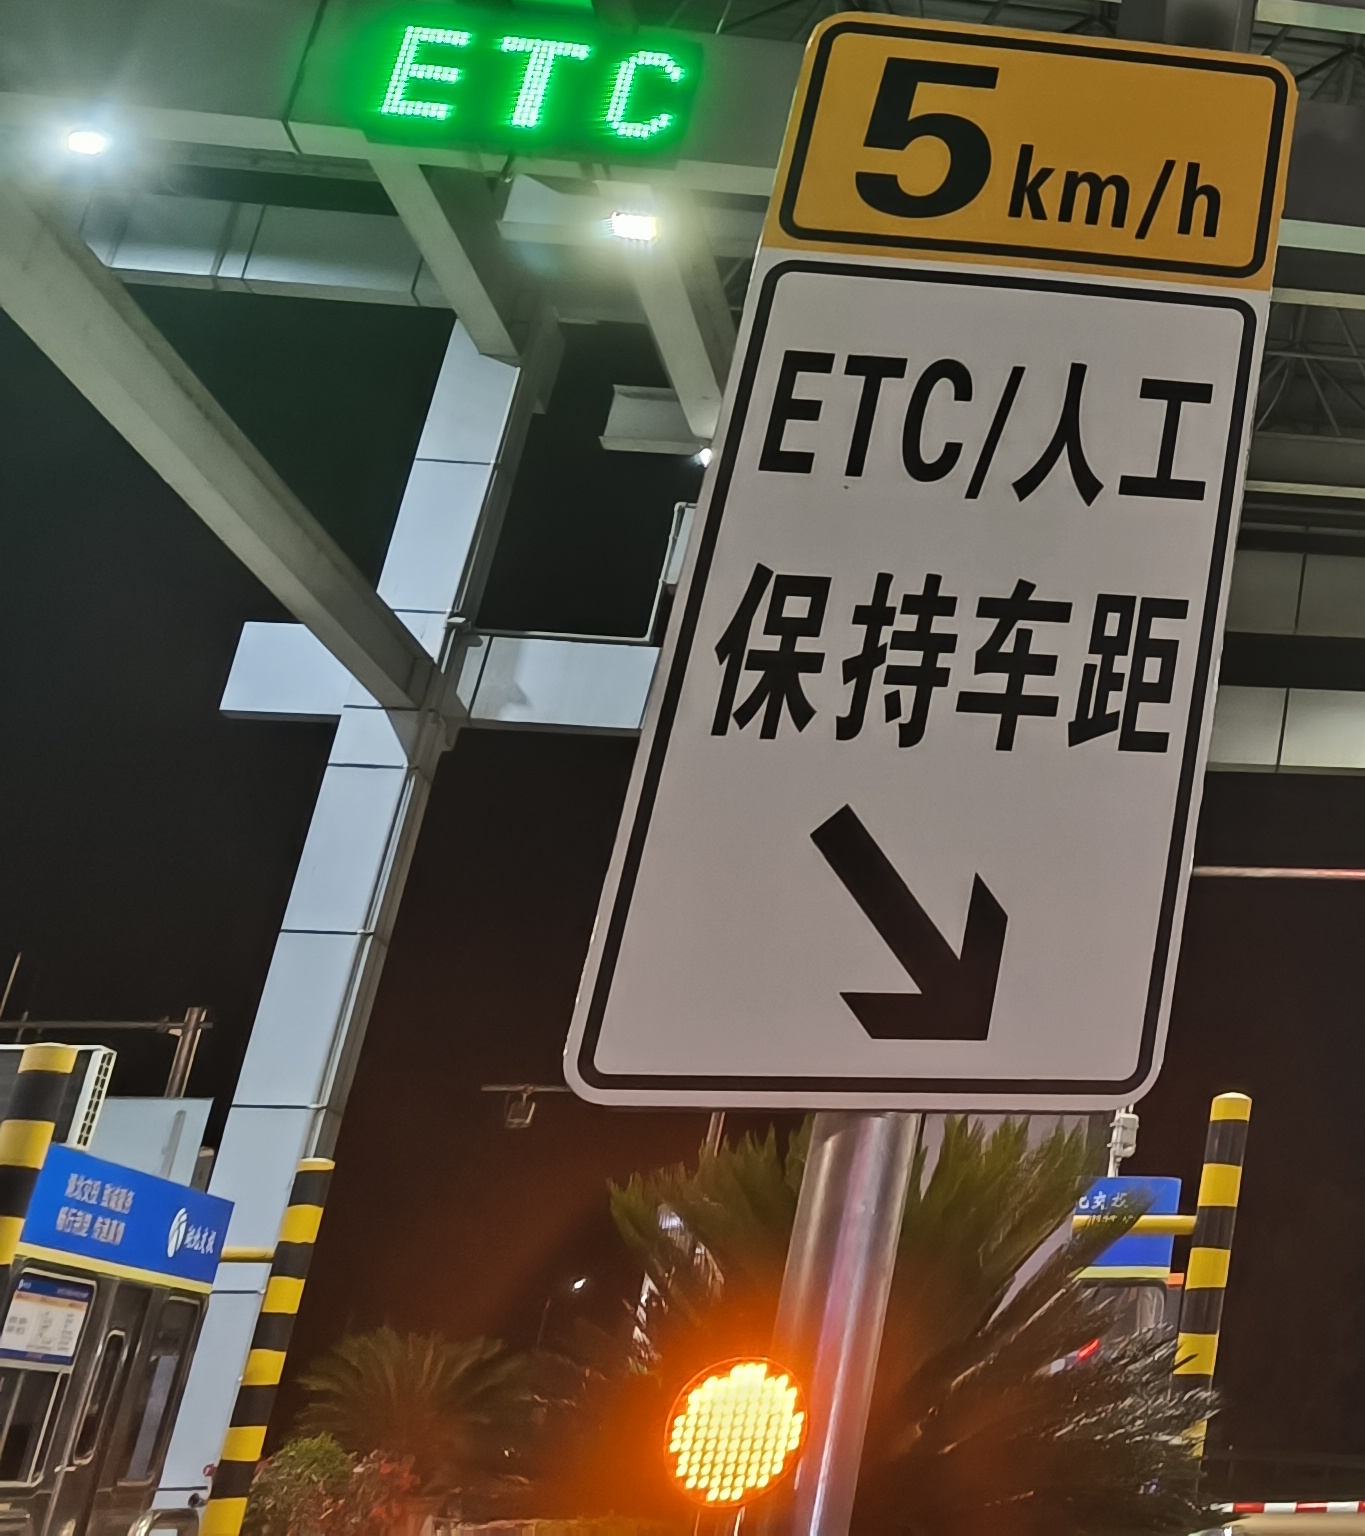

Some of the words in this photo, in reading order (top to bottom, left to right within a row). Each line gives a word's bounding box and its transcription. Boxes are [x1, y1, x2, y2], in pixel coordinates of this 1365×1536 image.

[381, 24, 686, 139] ETC
[855, 55, 1000, 220] 5
[1006, 143, 1222, 240] km/h
[758, 349, 1213, 507] ETC/人工
[710, 562, 1190, 753] 保持车距
